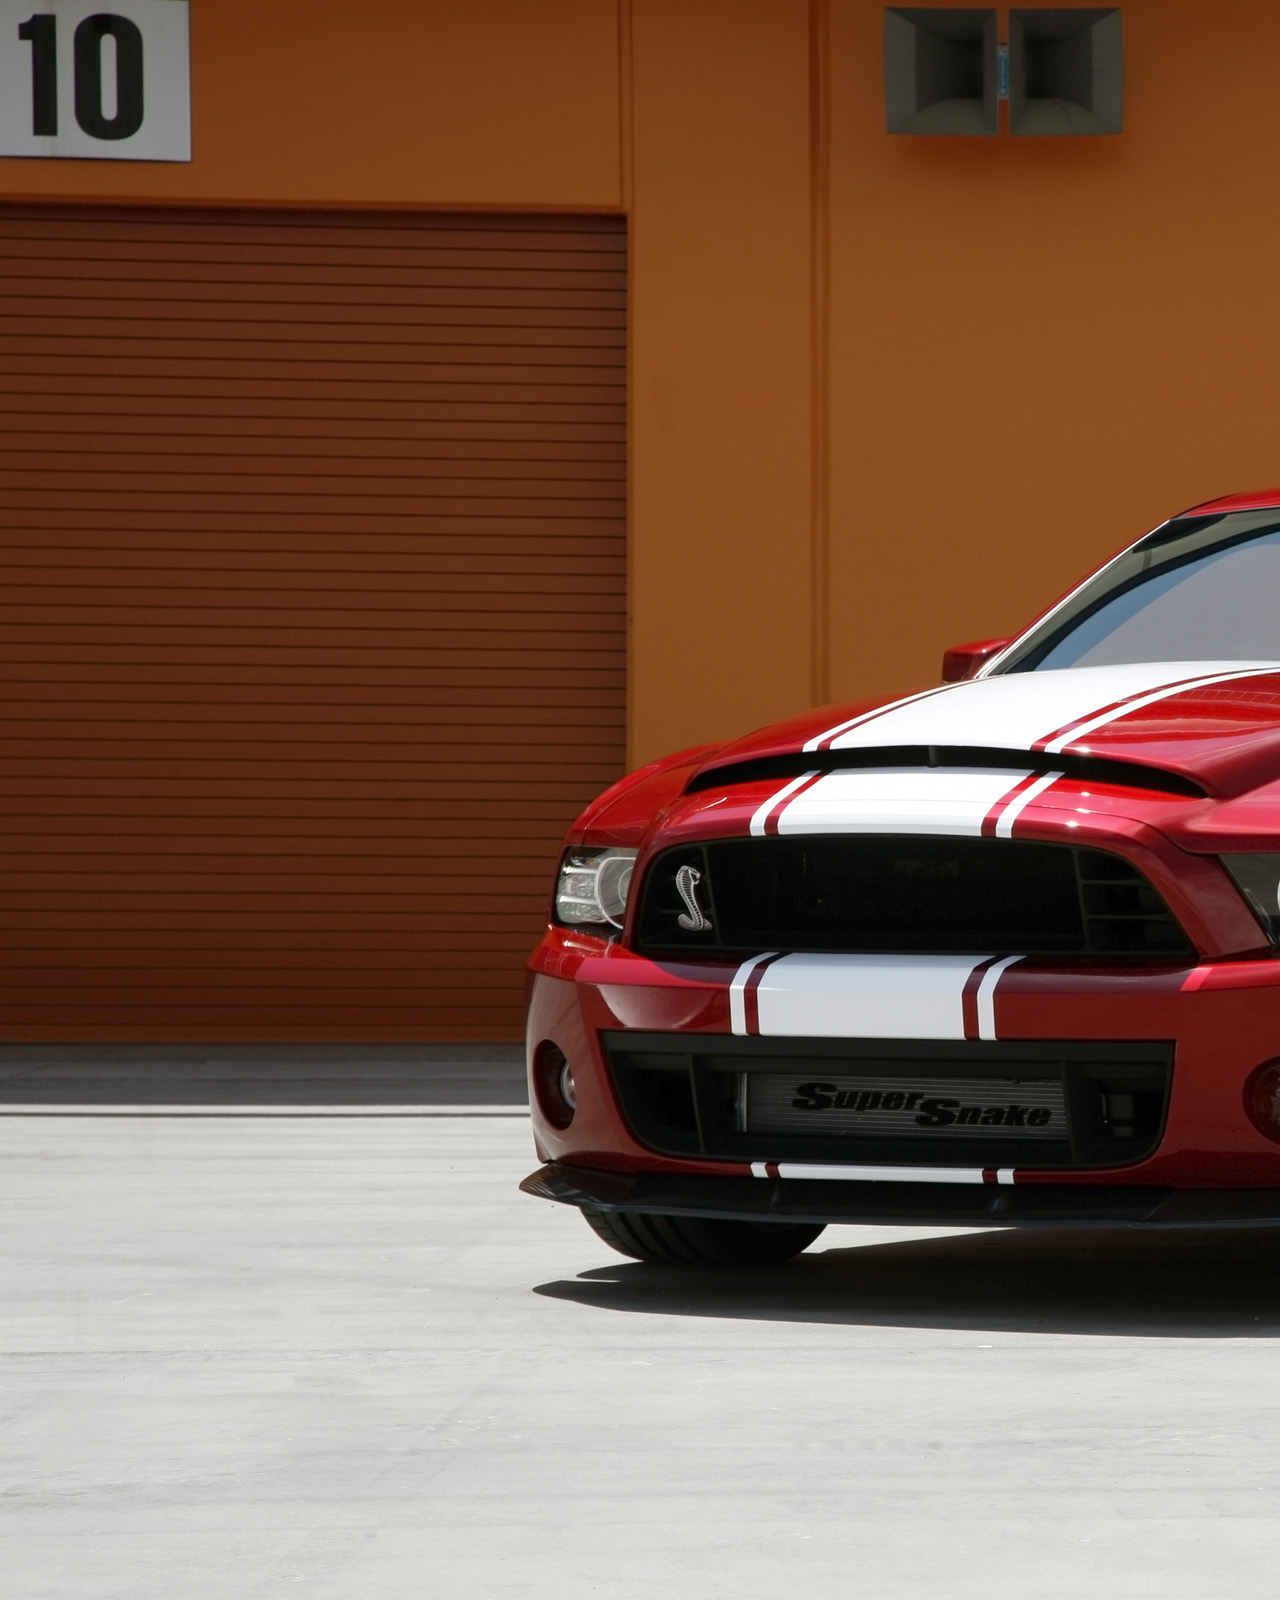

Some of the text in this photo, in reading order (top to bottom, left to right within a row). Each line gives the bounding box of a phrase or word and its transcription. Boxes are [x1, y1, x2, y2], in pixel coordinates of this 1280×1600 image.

[18, 13, 144, 141] 10
[792, 1082, 1051, 1127] Super Snake
